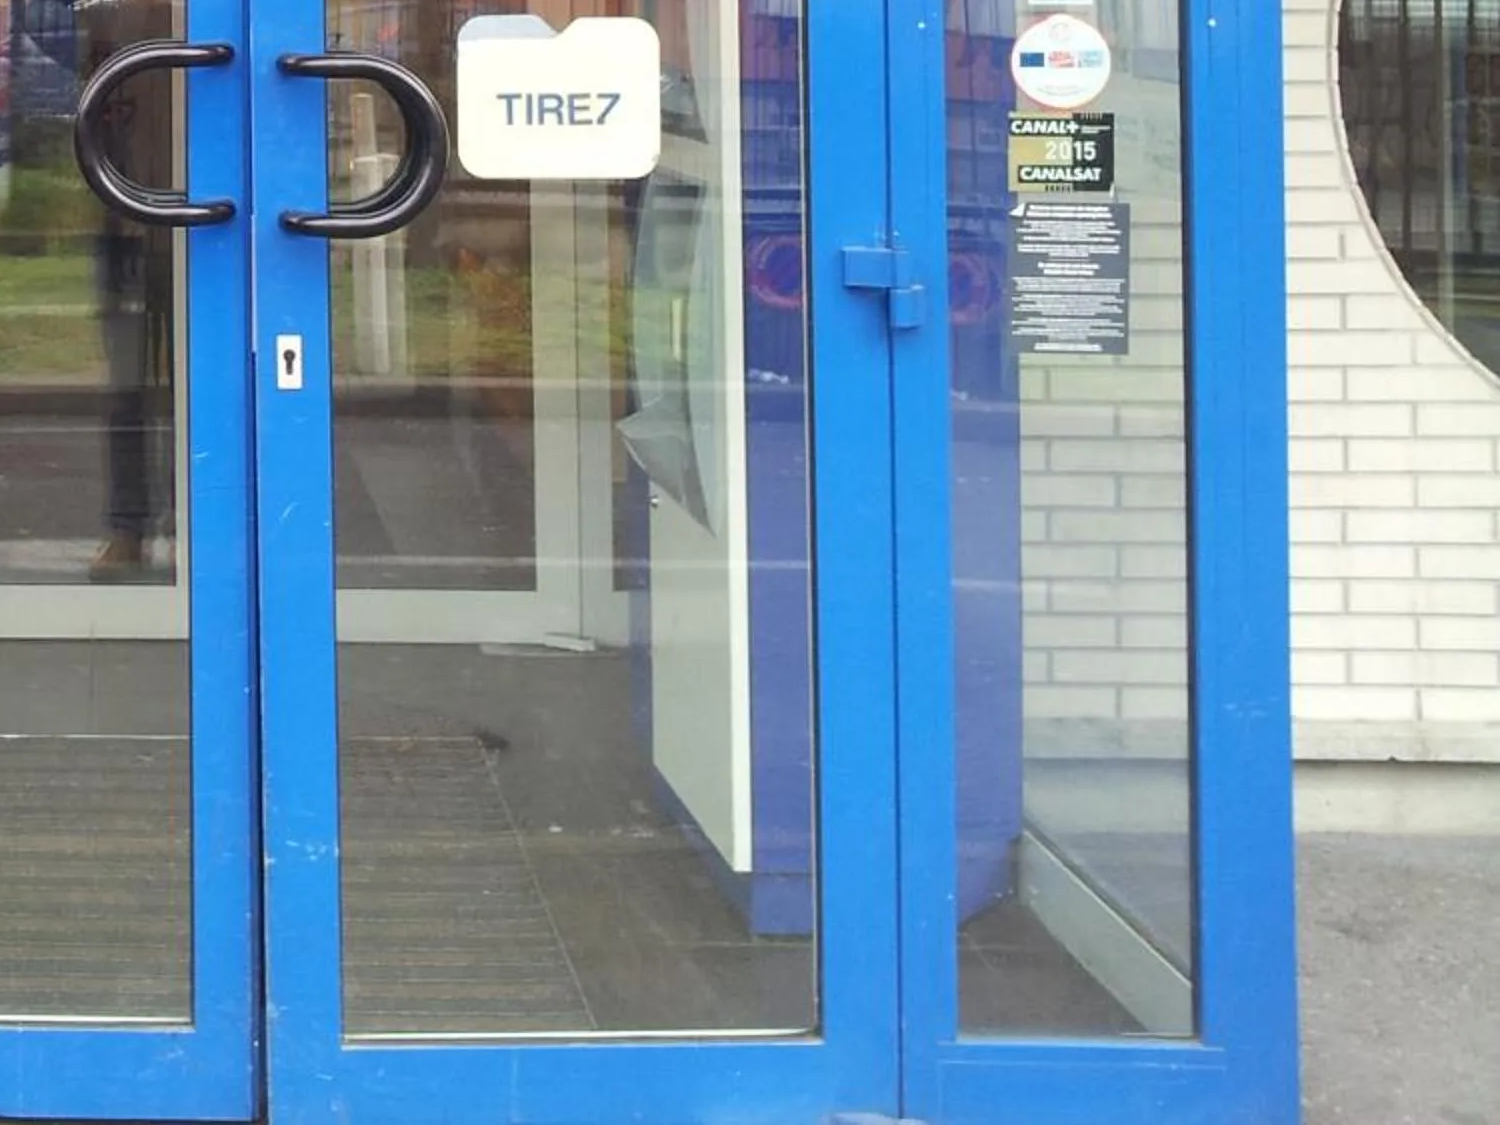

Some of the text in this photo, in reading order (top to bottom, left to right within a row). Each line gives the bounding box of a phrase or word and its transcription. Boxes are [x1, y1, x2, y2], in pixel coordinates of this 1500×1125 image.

[496, 92, 622, 126] TIRE7
[1010, 119, 1079, 134] CANAL+
[1044, 140, 1097, 161] 2015
[1019, 166, 1102, 182] CANALSAT
